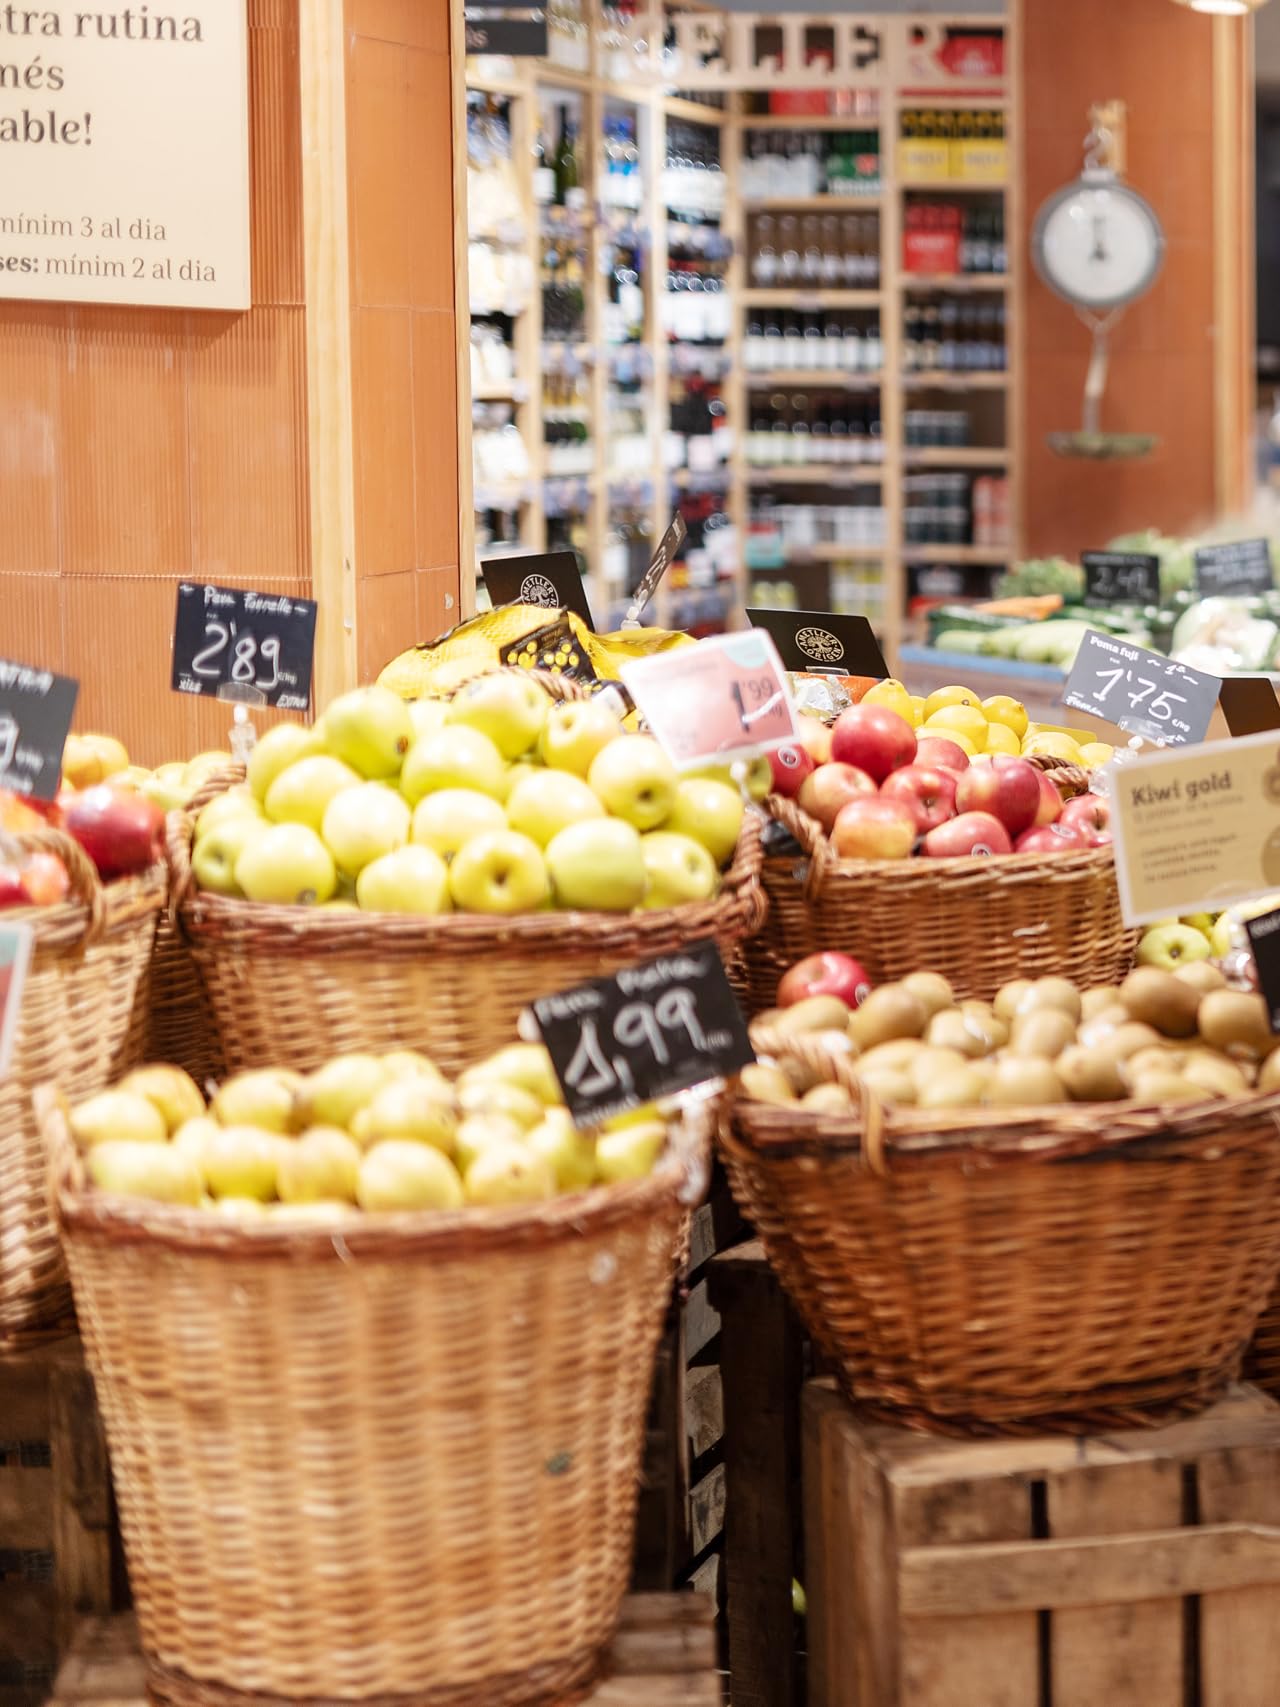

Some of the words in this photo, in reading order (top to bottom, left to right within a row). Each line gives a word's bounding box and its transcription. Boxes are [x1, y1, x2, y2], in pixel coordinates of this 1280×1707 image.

[0, 3, 62, 37] tra
[74, 5, 204, 42] rutina
[79, 215, 94, 238] 3
[100, 216, 121, 239] al
[128, 217, 167, 241] dia
[45, 252, 125, 278] mínim
[131, 256, 146, 279] 2
[151, 257, 172, 281] al
[178, 258, 217, 282] dia
[806, 646, 842, 661] ORIGEN
[1089, 635, 1120, 656] Poma
[1131, 778, 1181, 807] Kiwi
[1186, 771, 1232, 799] gold
